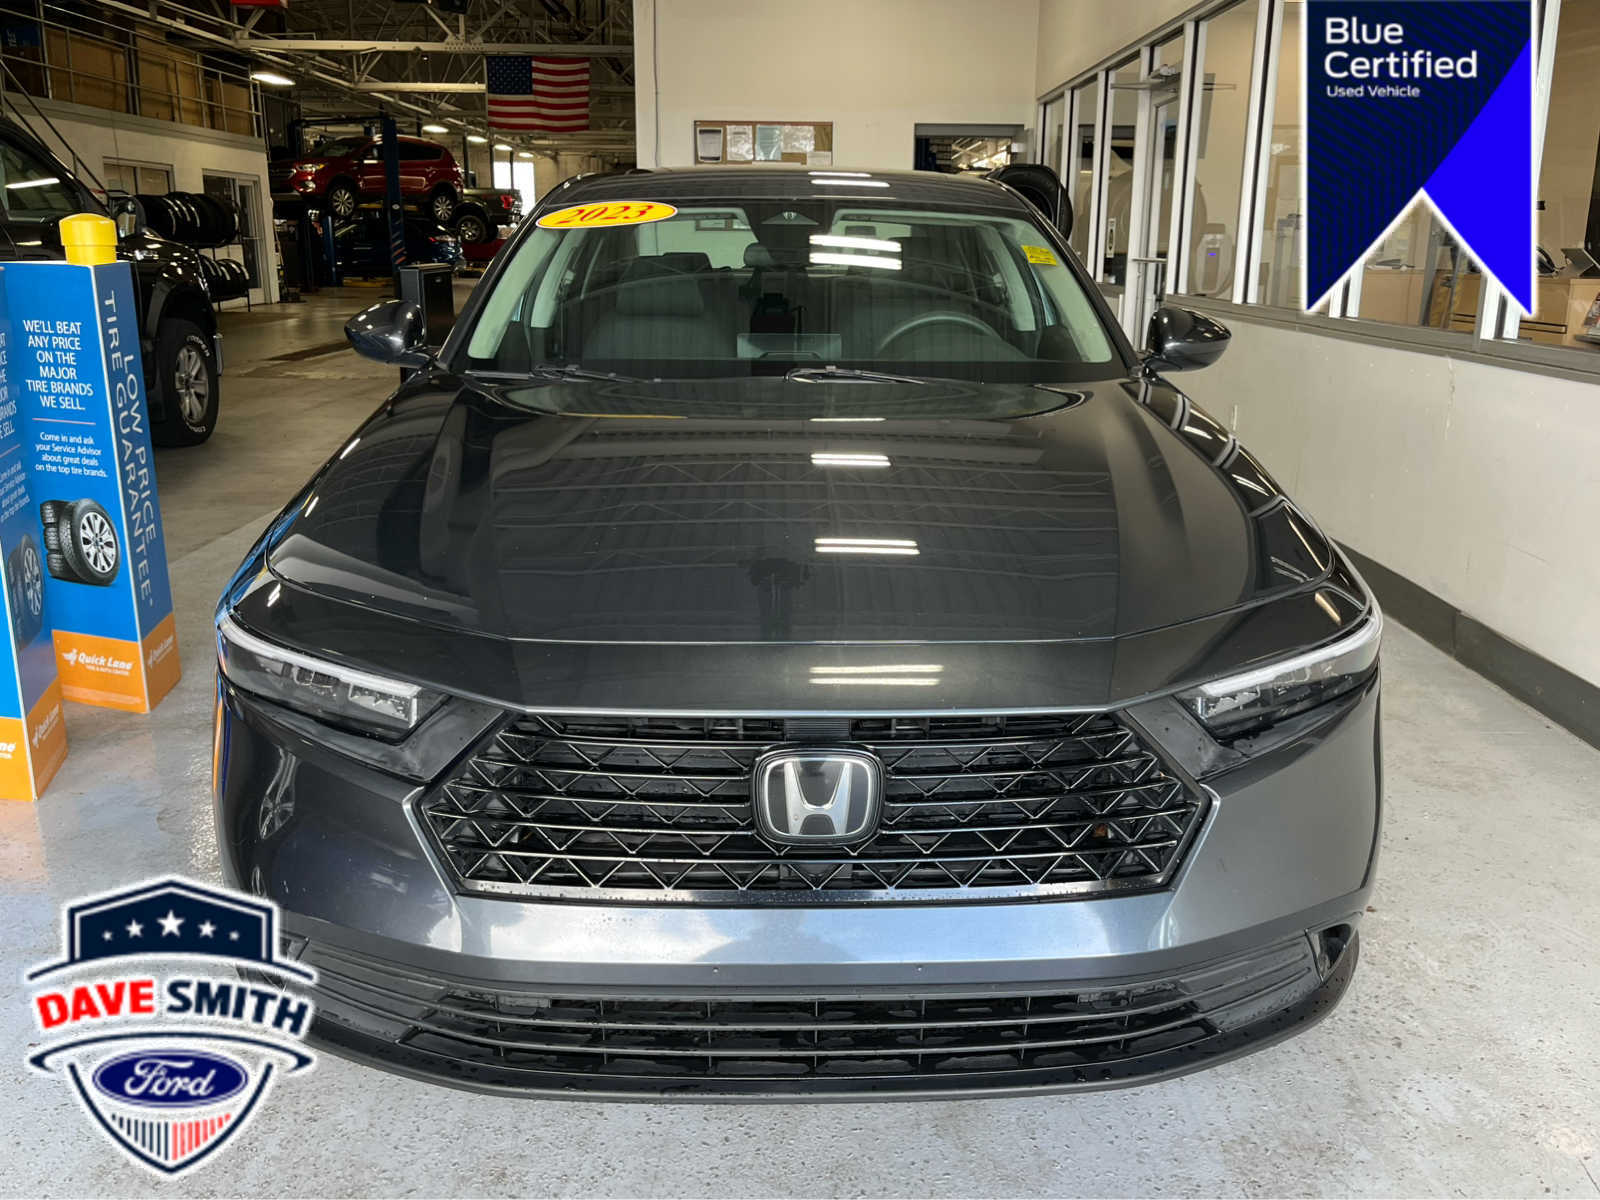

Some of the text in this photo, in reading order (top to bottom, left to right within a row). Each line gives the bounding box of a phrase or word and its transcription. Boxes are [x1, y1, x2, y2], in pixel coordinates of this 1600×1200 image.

[555, 205, 654, 224] 2023
[23, 319, 82, 334] WE'LL BEAT
[104, 290, 123, 372] TIRE
[28, 335, 82, 350] ANY PRICE
[36, 350, 77, 365] ON THE
[39, 366, 77, 380] MAJOR
[25, 379, 94, 396] TIRE BRANDS
[39, 395, 58, 408] WE
[40, 431, 60, 441] Come
[61, 433, 68, 443] in
[69, 434, 82, 444] and
[35, 443, 50, 452] your
[52, 443, 76, 453] Service
[124, 354, 157, 544] LOW PRICE
[42, 453, 62, 463] about
[63, 455, 80, 465] great
[45, 463, 57, 472] the
[58, 465, 70, 475] top
[78, 651, 106, 666] Quick
[107, 656, 133, 671] Lane
